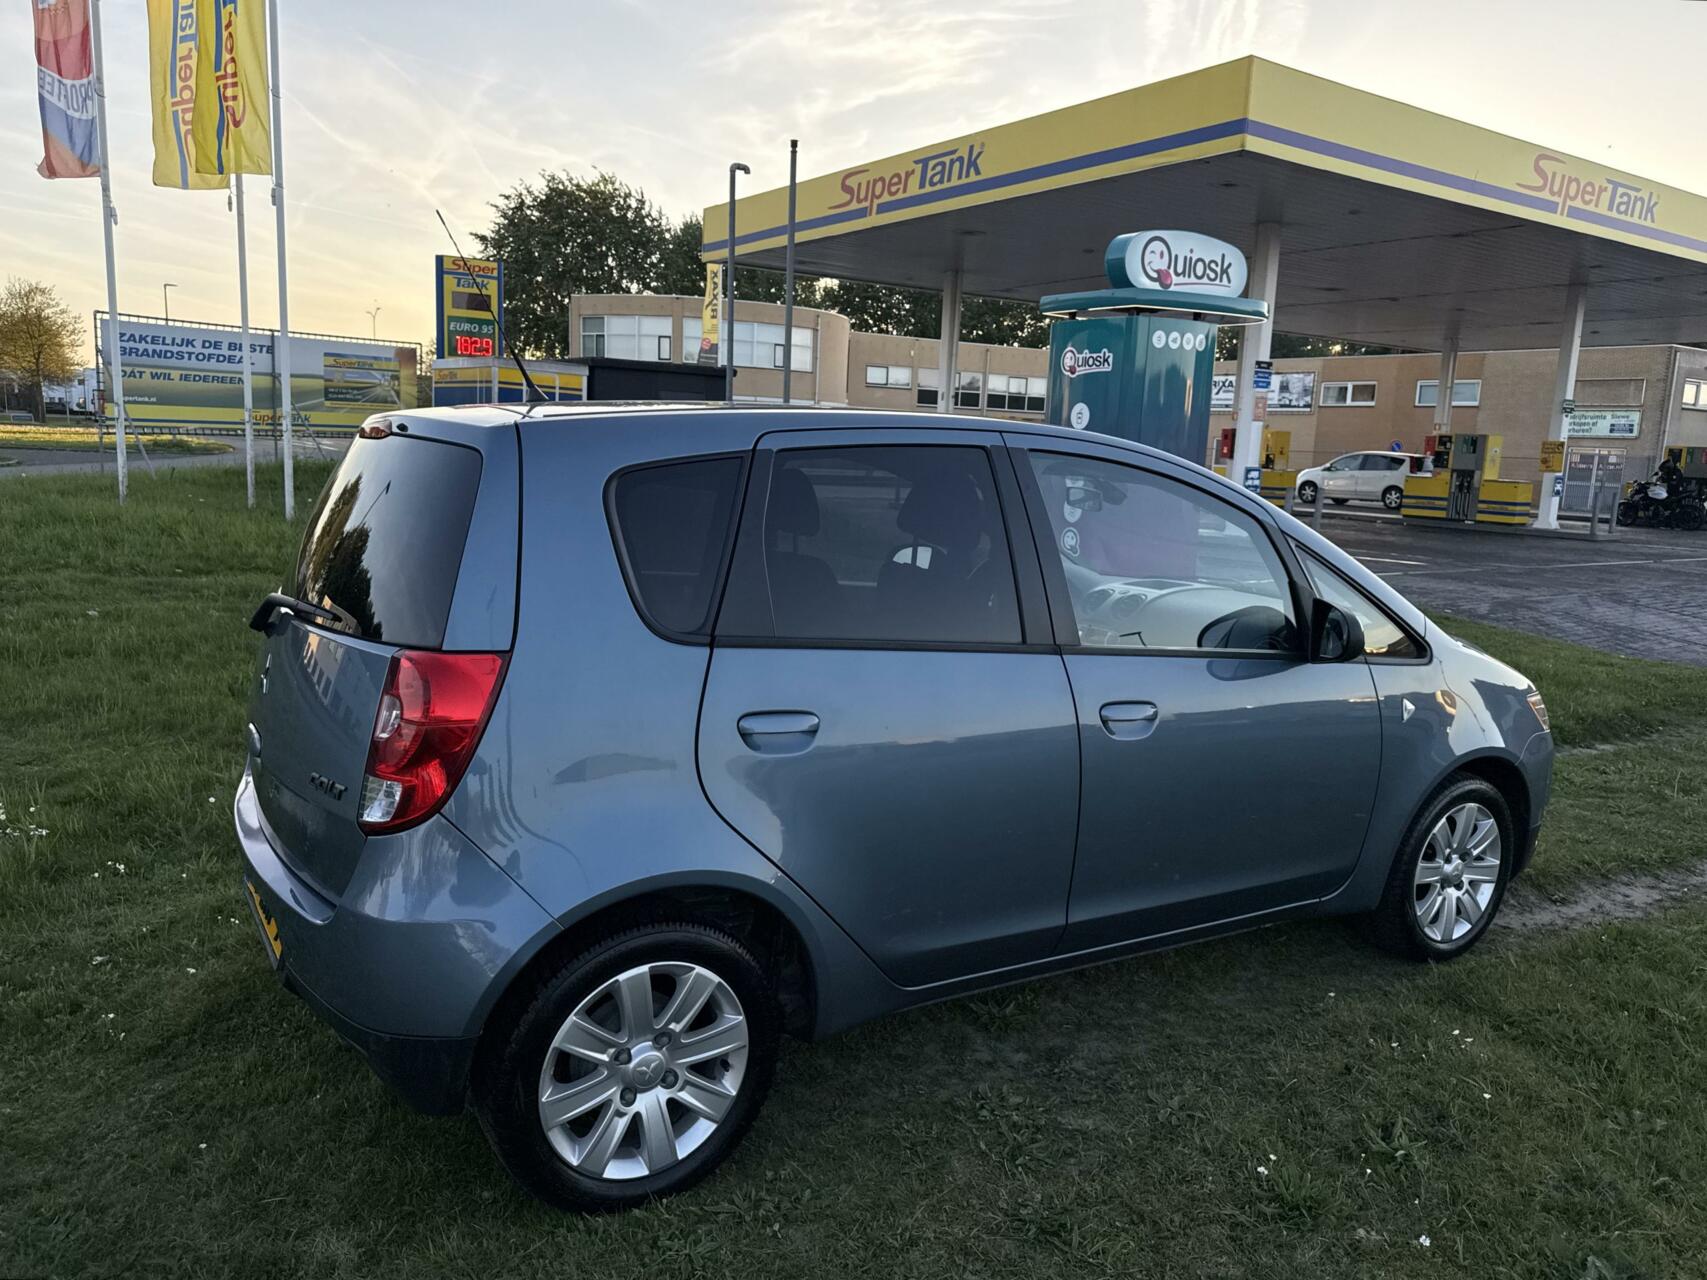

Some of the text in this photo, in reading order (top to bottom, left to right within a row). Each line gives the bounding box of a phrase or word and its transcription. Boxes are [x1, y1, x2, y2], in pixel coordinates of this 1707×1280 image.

[828, 143, 984, 217] SuperTank
[1515, 153, 1660, 224] SuperTank
[451, 259, 497, 276] Super
[1141, 236, 1232, 290] Quiosk
[453, 276, 489, 291] Tank
[449, 321, 494, 334] EURO 95
[118, 332, 197, 349] ZAKELIJK
[201, 339, 224, 351] DE
[1062, 349, 1111, 375] Quiosk
[150, 370, 175, 381] WIL
